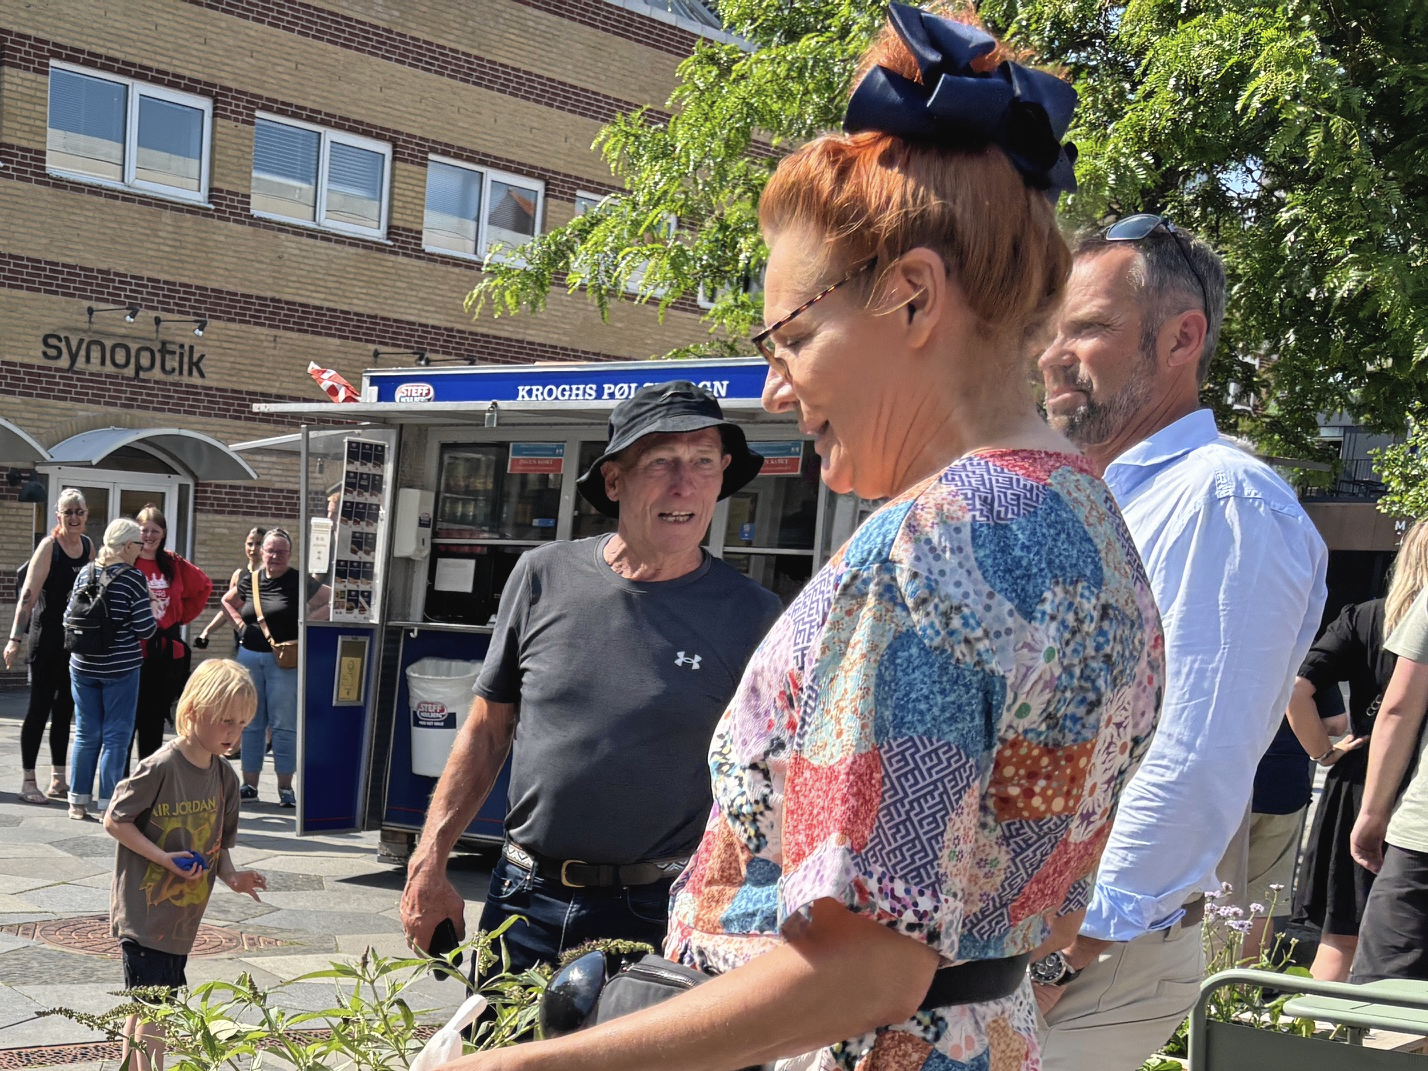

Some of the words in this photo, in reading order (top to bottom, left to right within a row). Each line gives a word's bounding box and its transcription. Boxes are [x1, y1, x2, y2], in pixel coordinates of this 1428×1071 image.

[41, 333, 207, 380] synoptik
[401, 386, 429, 397] STEFF
[517, 384, 597, 401] KROGHS
[602, 379, 729, 400] PØLGN
[420, 703, 442, 713] STEFF
[152, 802, 171, 818] AIR
[173, 795, 217, 817] JORDAN
